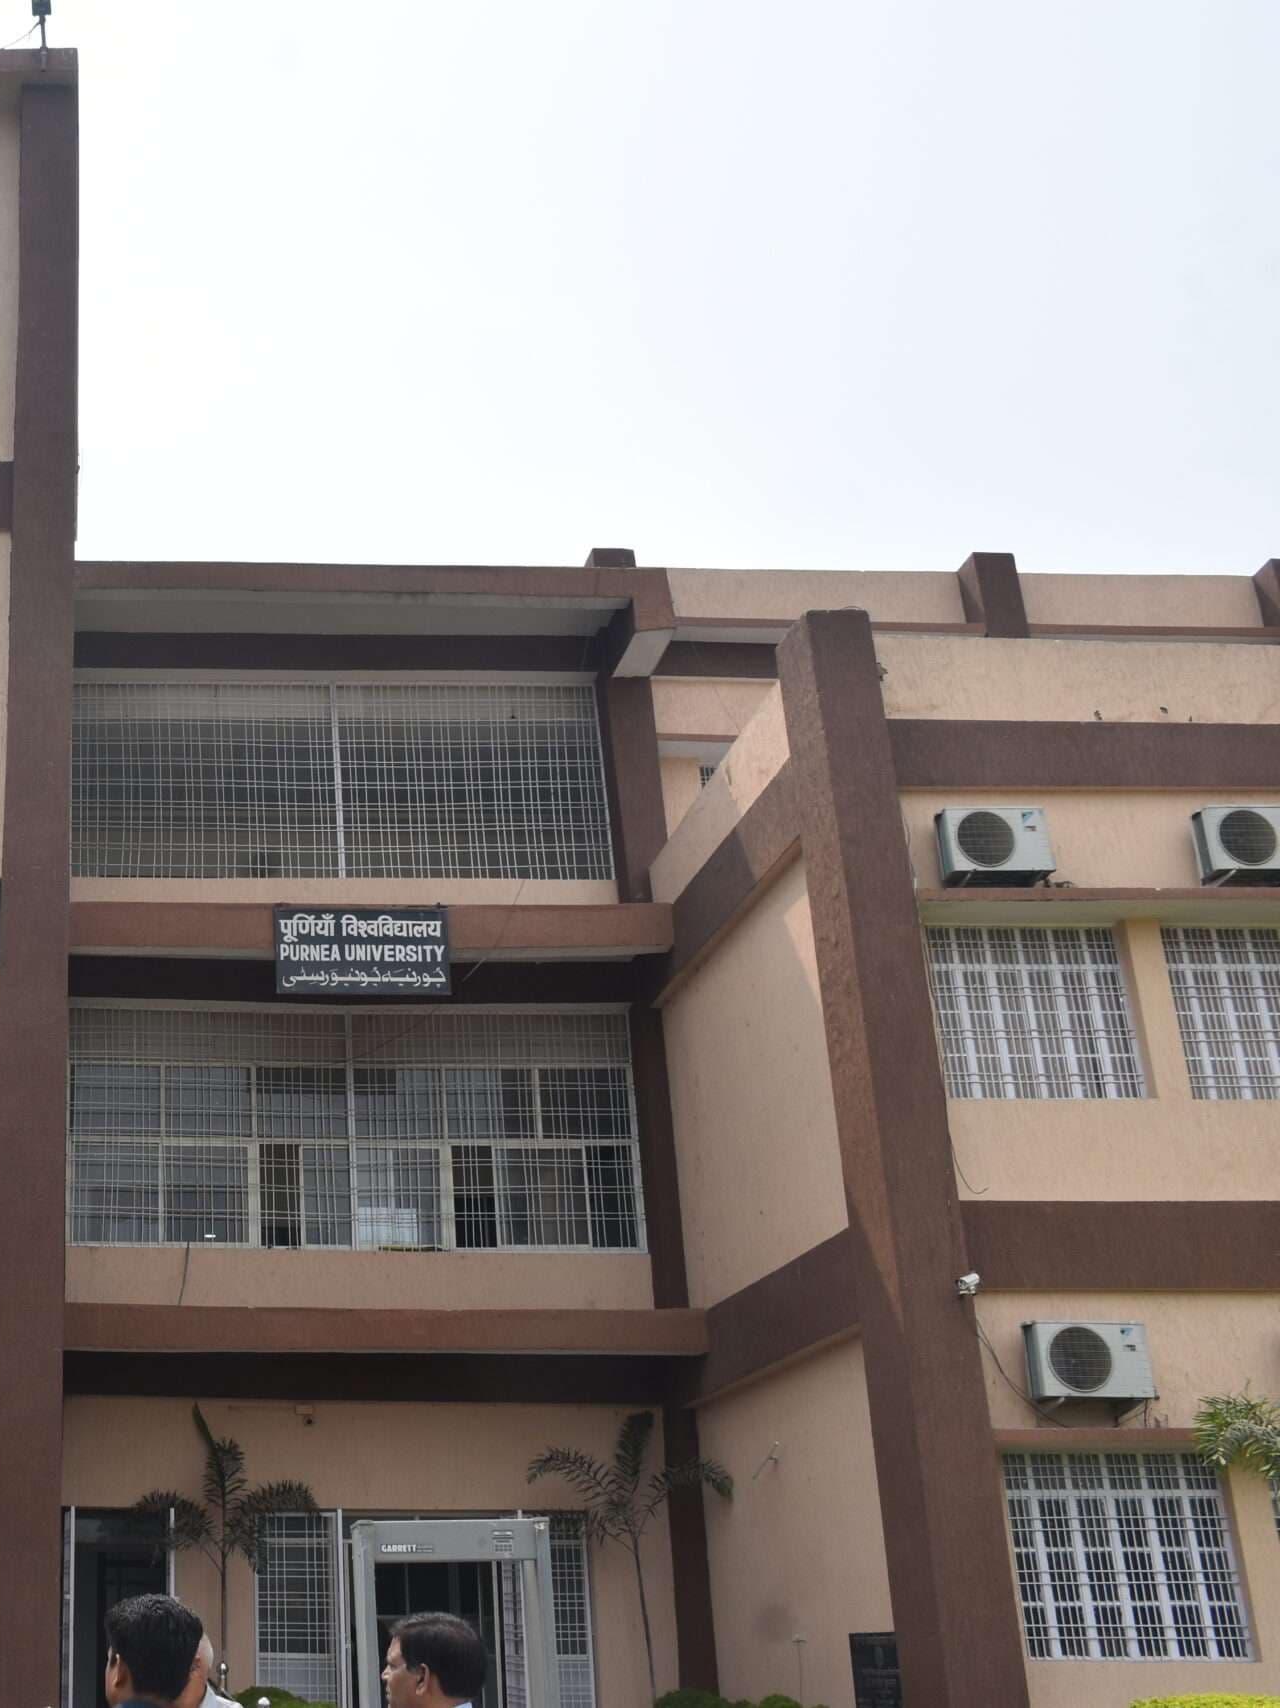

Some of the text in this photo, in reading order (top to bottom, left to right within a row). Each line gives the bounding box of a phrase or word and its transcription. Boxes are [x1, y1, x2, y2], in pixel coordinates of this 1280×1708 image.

[279, 913, 442, 943] पूर्णियाँ विश्वविद्यालय
[280, 943, 445, 962] PURNEA UNIVERSITY
[381, 1544, 417, 1553] GARRETT
